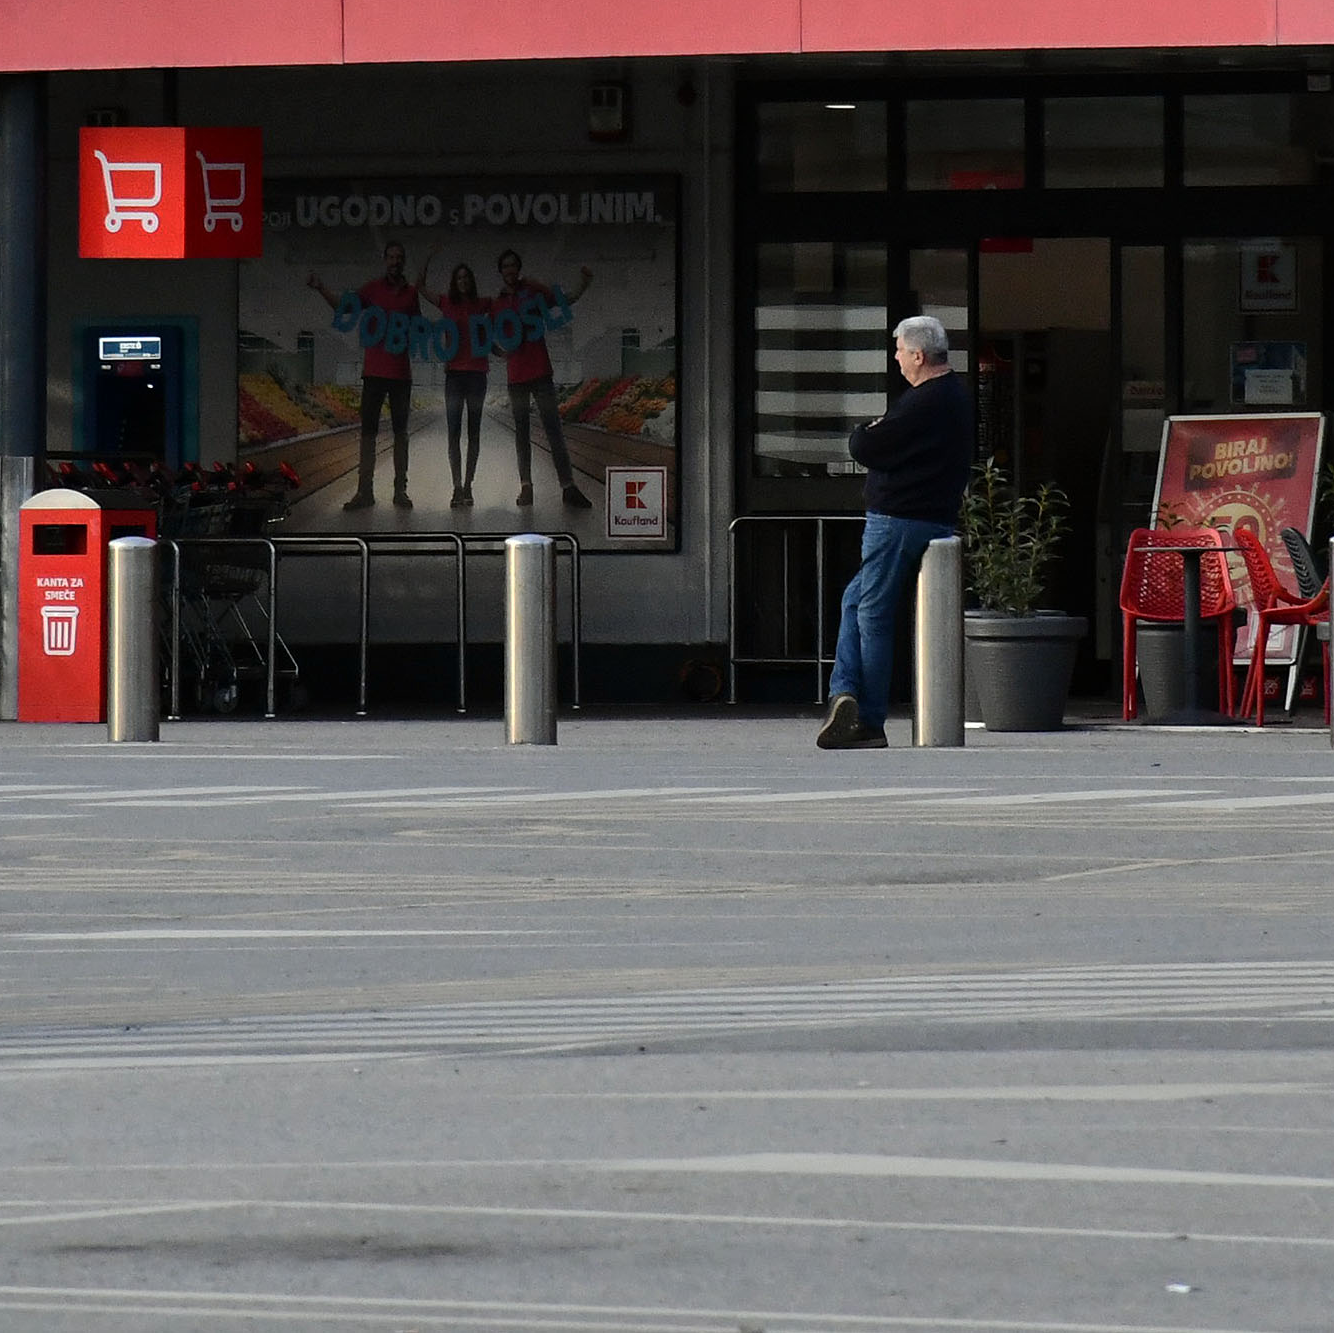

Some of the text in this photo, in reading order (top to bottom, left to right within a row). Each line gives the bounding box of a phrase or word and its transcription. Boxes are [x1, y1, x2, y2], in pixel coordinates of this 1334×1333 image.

[296, 193, 443, 228] UGODNO
[463, 191, 662, 227] POVOLJNIM.
[331, 288, 460, 363] DOBRO
[1214, 437, 1268, 460] BIRAJ
[614, 514, 659, 527] Kaufland
[37, 577, 84, 588] KANTA ZA
